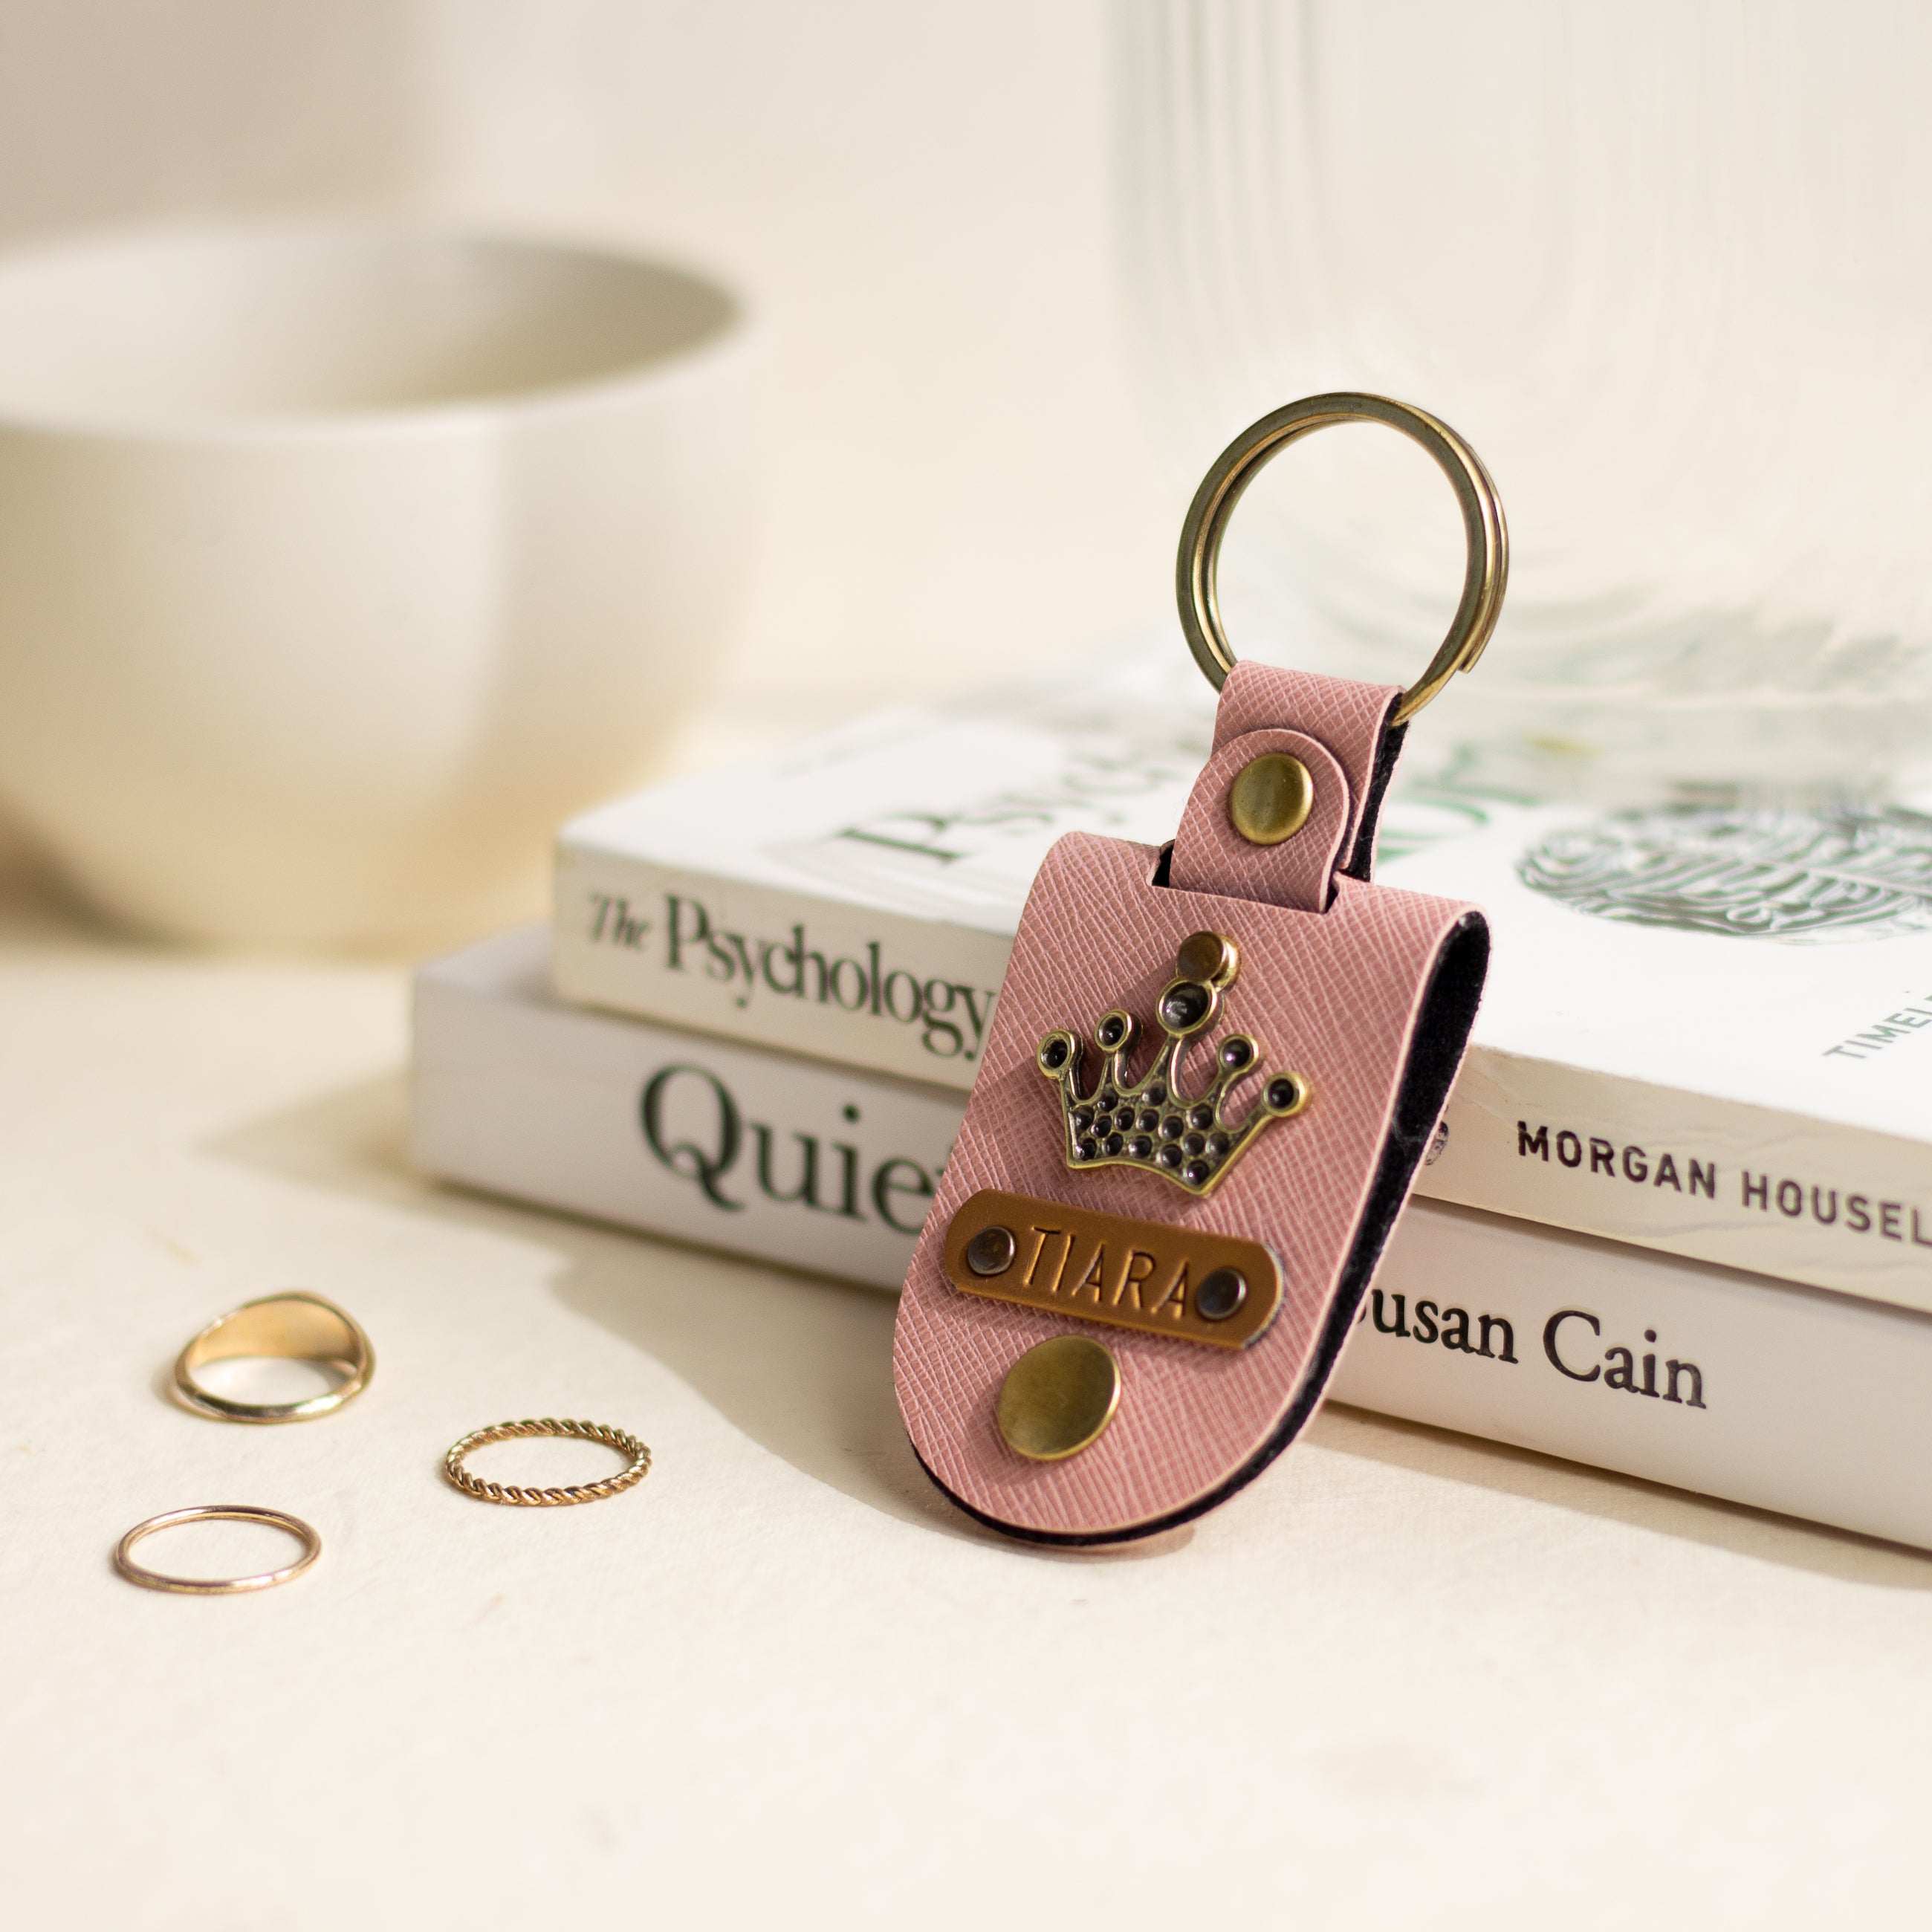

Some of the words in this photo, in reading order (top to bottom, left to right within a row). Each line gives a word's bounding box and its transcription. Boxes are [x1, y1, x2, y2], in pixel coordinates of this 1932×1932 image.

[589, 893, 652, 951] The
[665, 893, 997, 1063] Psychology
[1821, 993, 1932, 1059] TIMEL
[639, 1063, 954, 1236] Quie
[1518, 1120, 1717, 1200] MORGAN
[1742, 1168, 1932, 1249] HOUSEL
[1021, 1223, 1190, 1321] TIARA
[1355, 1288, 1520, 1365] usan
[1543, 1309, 1708, 1410] Cain
